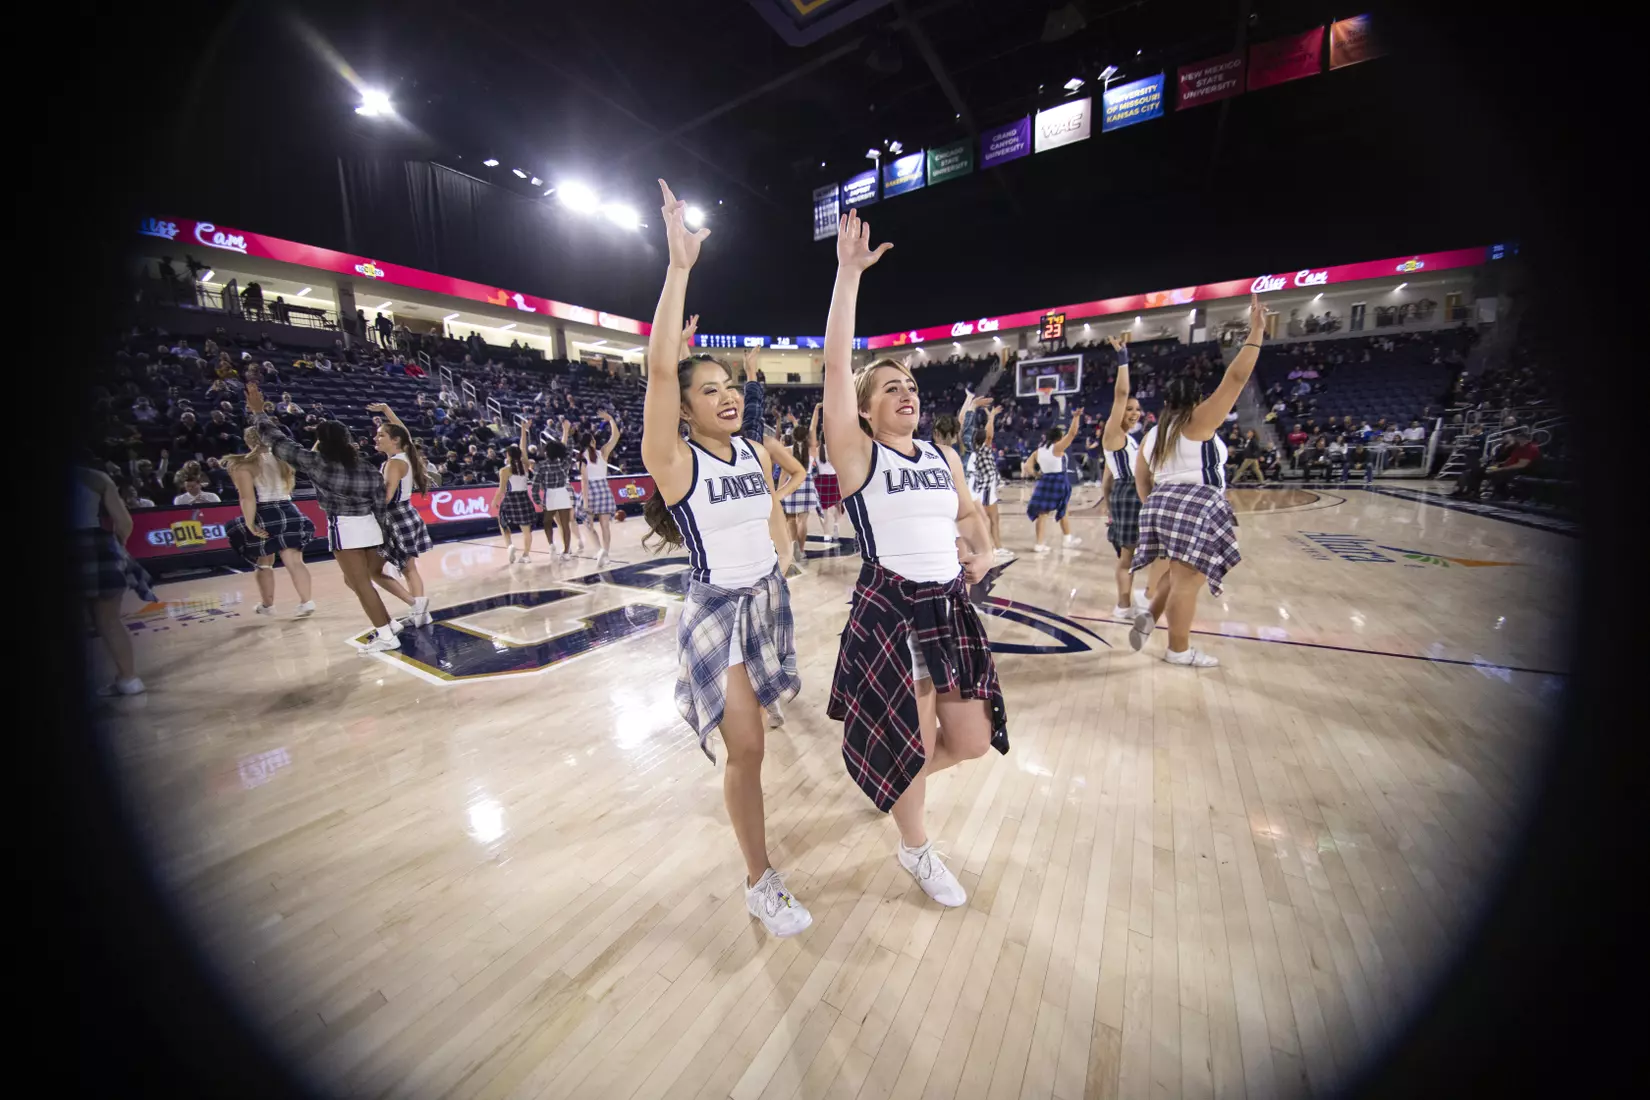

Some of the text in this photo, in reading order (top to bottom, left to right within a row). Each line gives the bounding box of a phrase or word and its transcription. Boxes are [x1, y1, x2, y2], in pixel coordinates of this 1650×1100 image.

[1181, 60, 1241, 83] NEW MEXICO
[1196, 73, 1224, 88] STATE
[1183, 79, 1237, 100] UNIVERSITY
[1106, 93, 1160, 115] OF MISSOURI
[1106, 102, 1160, 124] KANSAS CITY
[992, 129, 1017, 142] GRAND
[1041, 113, 1083, 139] WAC
[985, 142, 1025, 160] UNIVERSITY
[989, 136, 1019, 150] CANYON
[933, 161, 968, 177] UNIVERSITY
[194, 221, 247, 254] Cam
[1294, 269, 1329, 287] Cam
[1044, 324, 1062, 338] 23
[431, 491, 491, 521] Cam
